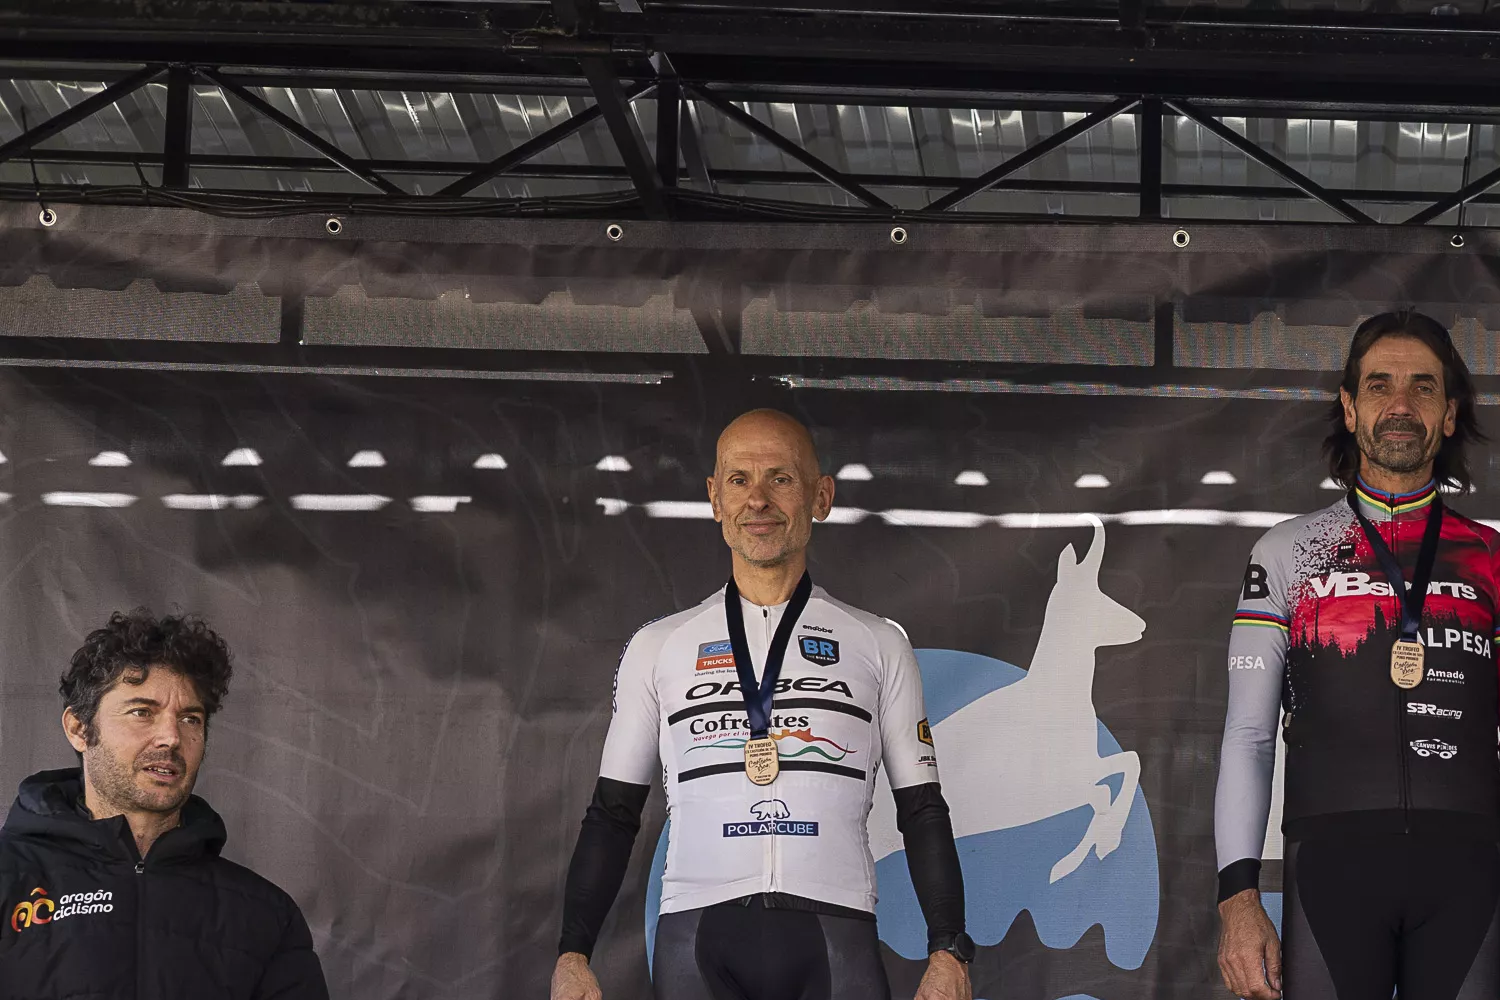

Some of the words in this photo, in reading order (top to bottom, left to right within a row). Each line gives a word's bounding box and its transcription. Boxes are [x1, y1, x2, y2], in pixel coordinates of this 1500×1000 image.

[803, 639, 835, 657] BR
[702, 658, 733, 667] TRUCKS
[728, 823, 814, 835] POLARCUBE
[53, 902, 114, 921] ciclismo
